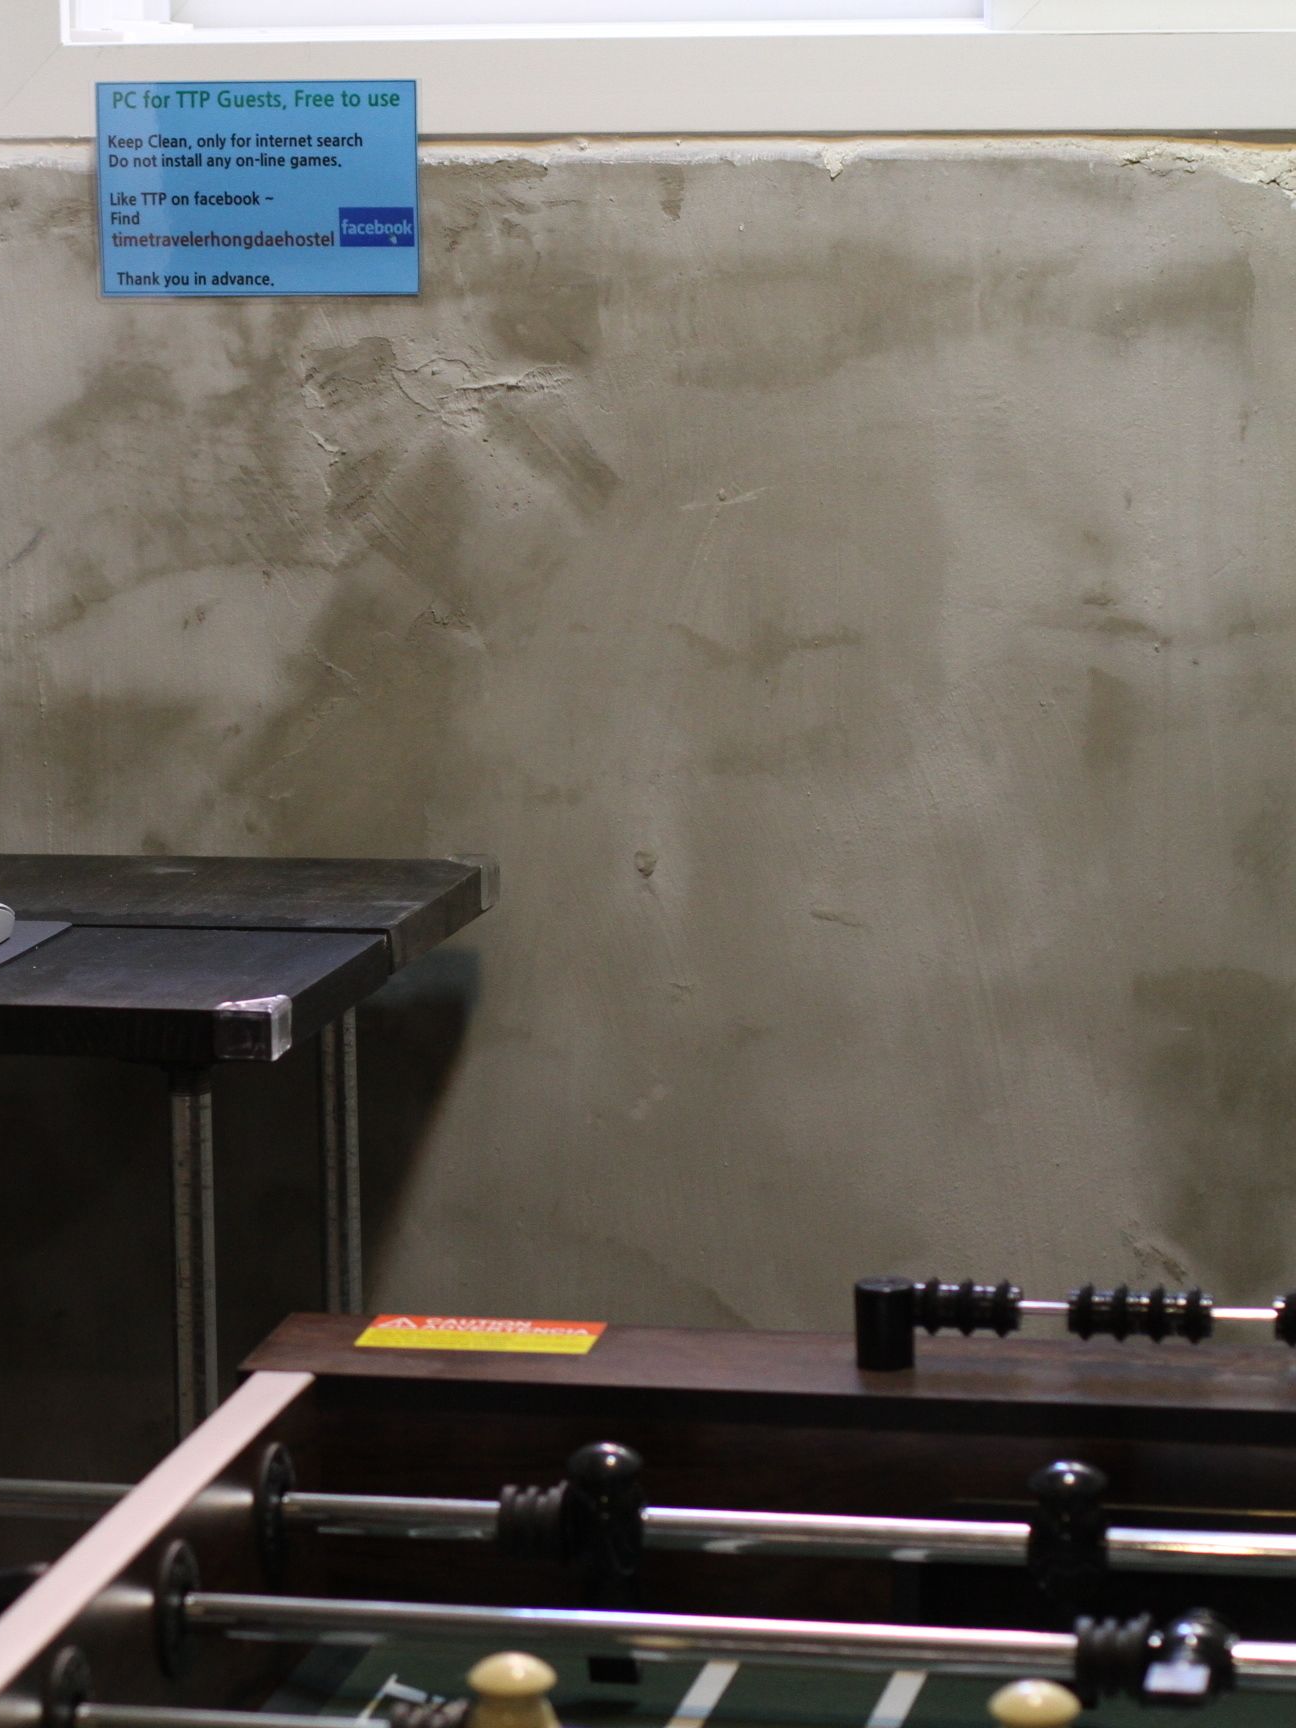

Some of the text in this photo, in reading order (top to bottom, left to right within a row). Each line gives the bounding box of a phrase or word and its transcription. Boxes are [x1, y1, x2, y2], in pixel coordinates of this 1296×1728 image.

[113, 90, 400, 111] PC for TTP Guests, Free to use
[107, 133, 363, 150] Keep Clean, only for internet search
[108, 153, 342, 169] Do not install any on-line games.
[110, 193, 136, 206] Like
[141, 193, 167, 206] TTP
[171, 195, 189, 205] on
[194, 192, 260, 205] facebook
[111, 211, 140, 225] Find
[341, 218, 413, 235] facebook
[112, 231, 334, 249] timetravelerhongdaehostel
[117, 272, 275, 288] Thank you in advance.
[422, 1317, 531, 1332] CAUTION
